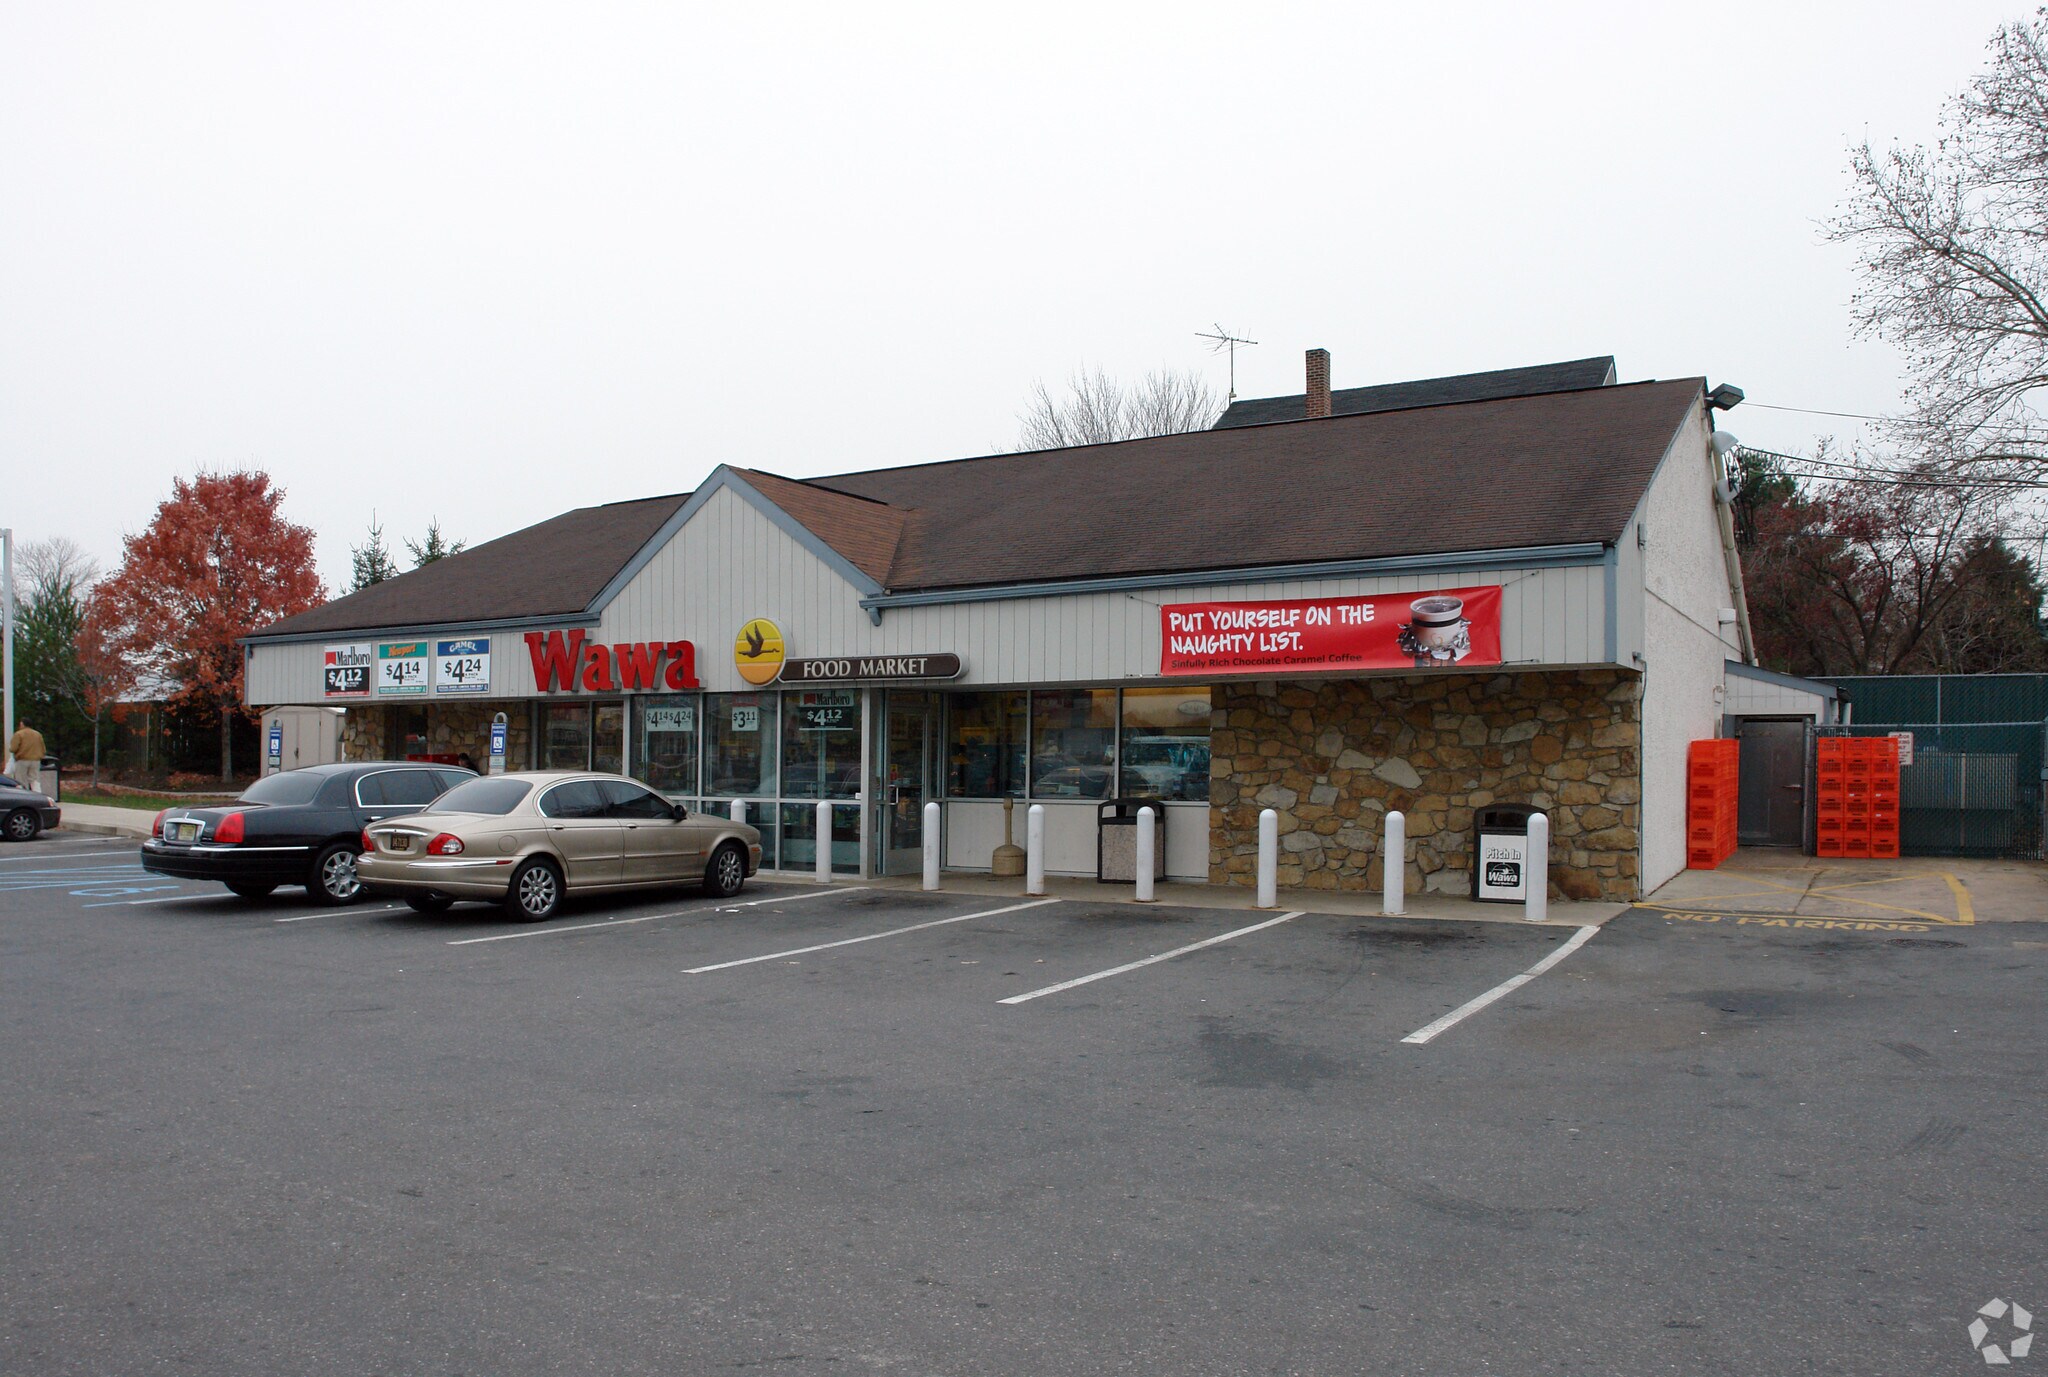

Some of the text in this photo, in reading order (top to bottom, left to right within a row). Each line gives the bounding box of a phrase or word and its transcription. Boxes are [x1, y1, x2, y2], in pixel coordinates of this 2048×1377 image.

[1169, 604, 1375, 632] PUT YOURSELF ON THE
[449, 641, 477, 652] CAMEL
[1171, 631, 1303, 655] NAUGHTY LIST.
[337, 646, 370, 666] Marlboro
[524, 628, 700, 692] Wawa
[1171, 653, 1363, 669] Sinfully Rich Chocolate Caramel Coffee
[386, 661, 420, 685] $414
[445, 658, 481, 682] $424
[803, 657, 928, 678] FOOD MARKET
[328, 669, 362, 692] $412
[816, 691, 850, 706] Marlboro
[647, 711, 668, 728] $414
[669, 711, 691, 728] $424
[733, 711, 756, 728] $311
[807, 709, 842, 726] $412
[1486, 847, 1521, 860] Pitch In
[1488, 872, 1517, 882] Wawa
[1662, 913, 1930, 932] NO PARKING
